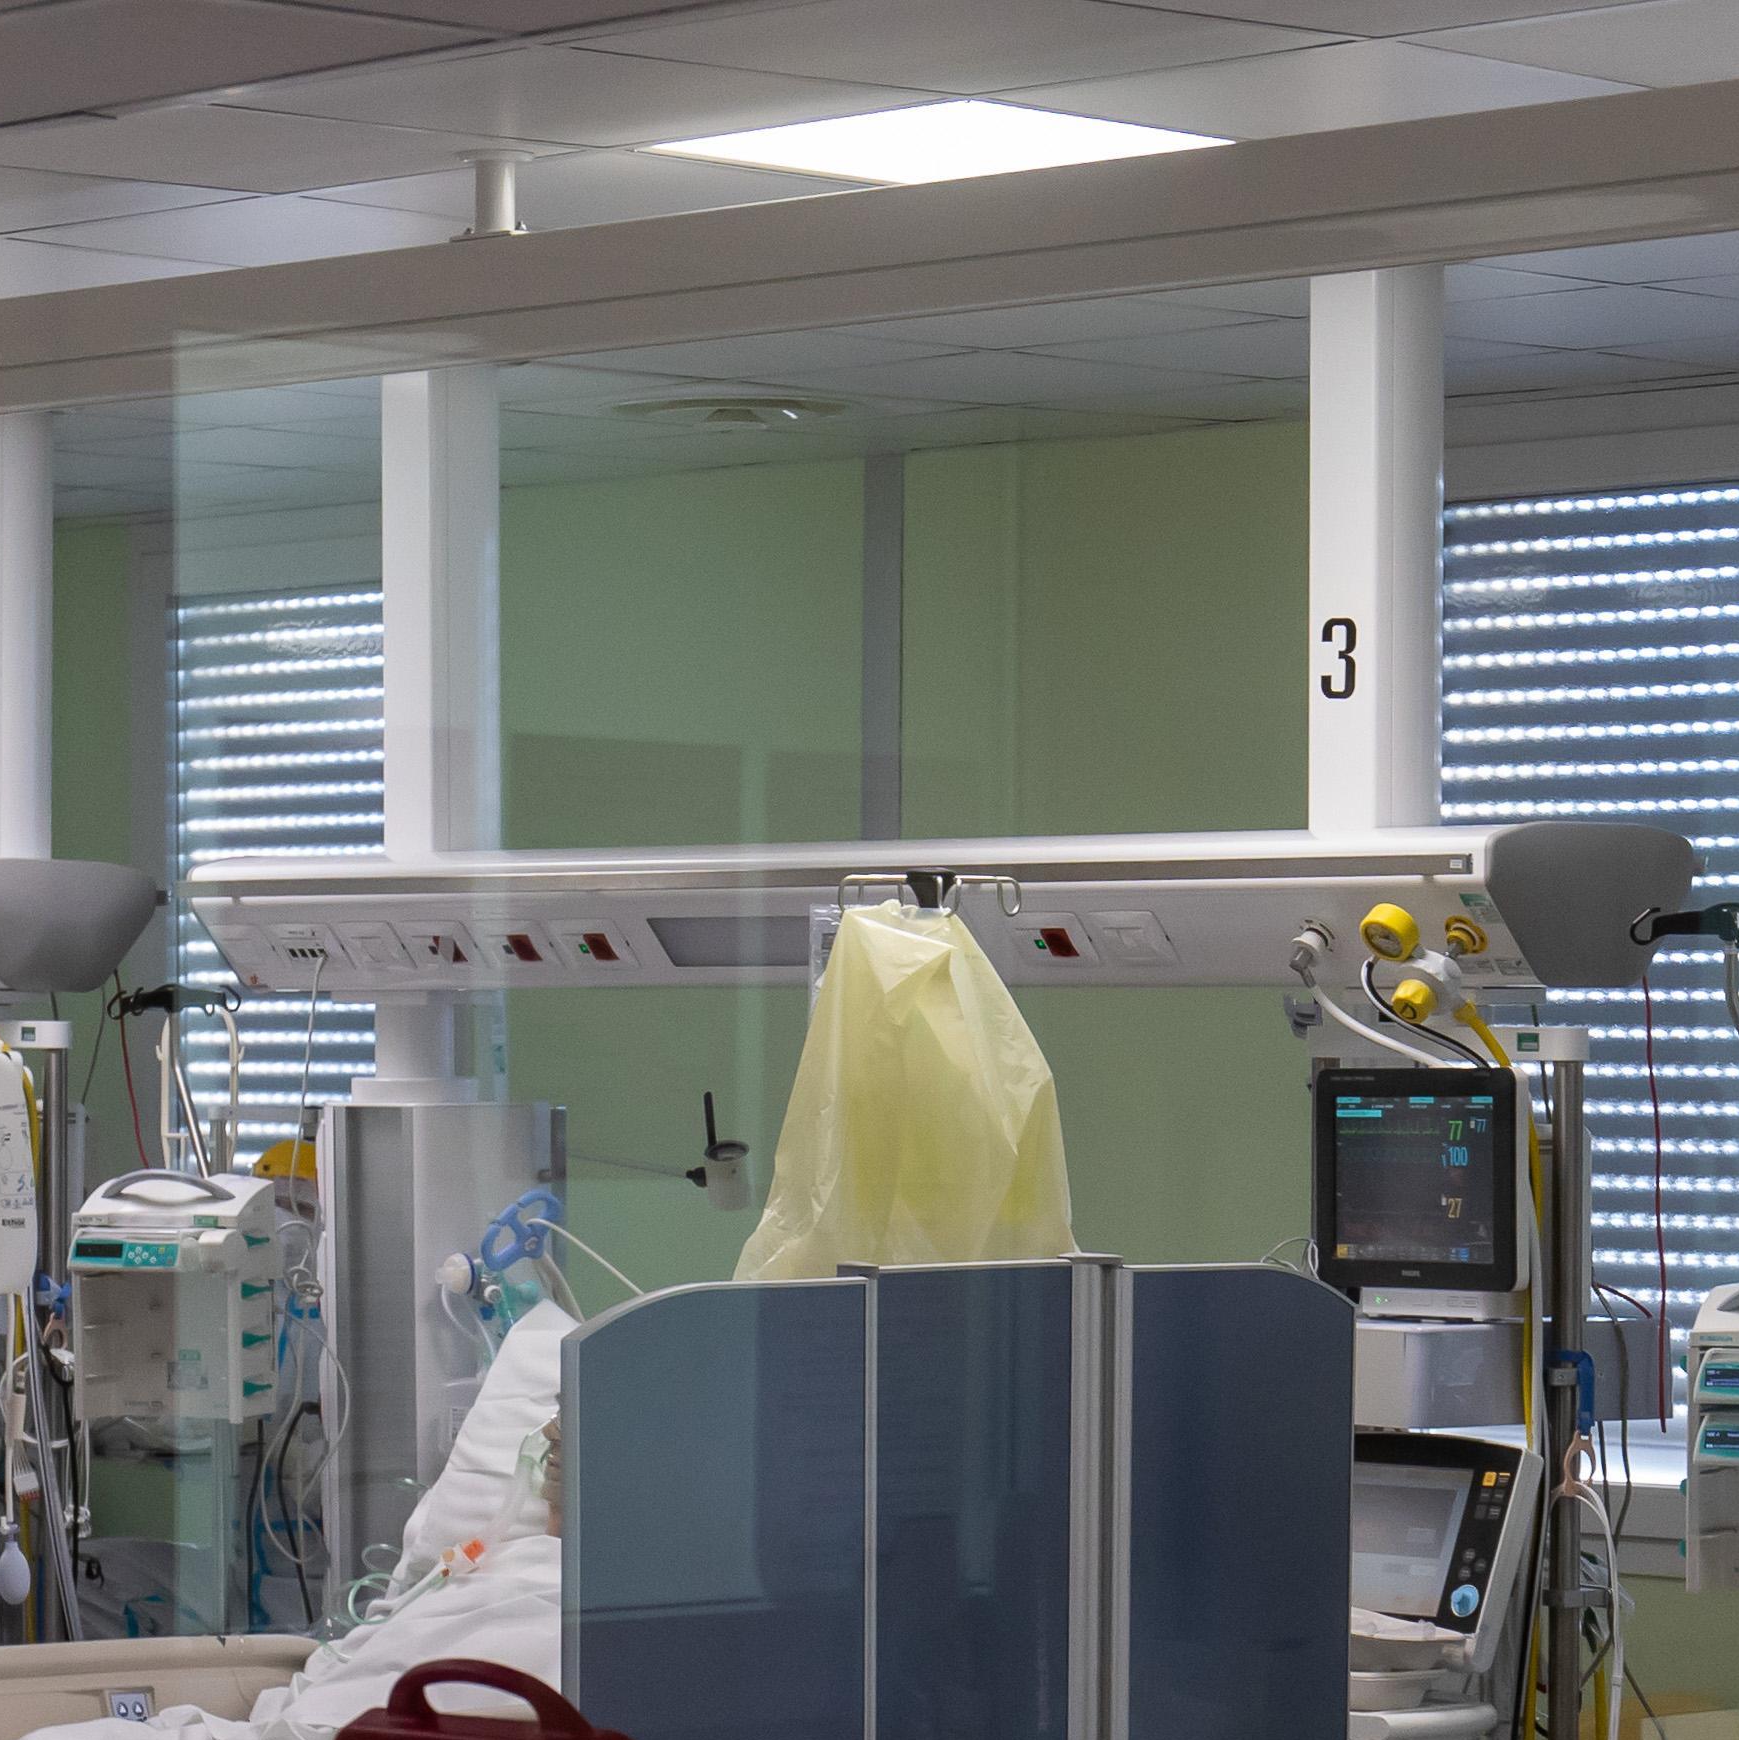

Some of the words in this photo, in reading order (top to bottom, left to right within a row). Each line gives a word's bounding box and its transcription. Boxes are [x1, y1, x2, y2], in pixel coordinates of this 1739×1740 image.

[1321, 617, 1357, 700] 3
[1448, 1120, 1463, 1140] 77
[1448, 1146, 1468, 1167] 100
[1448, 1198, 1463, 1218] 27
